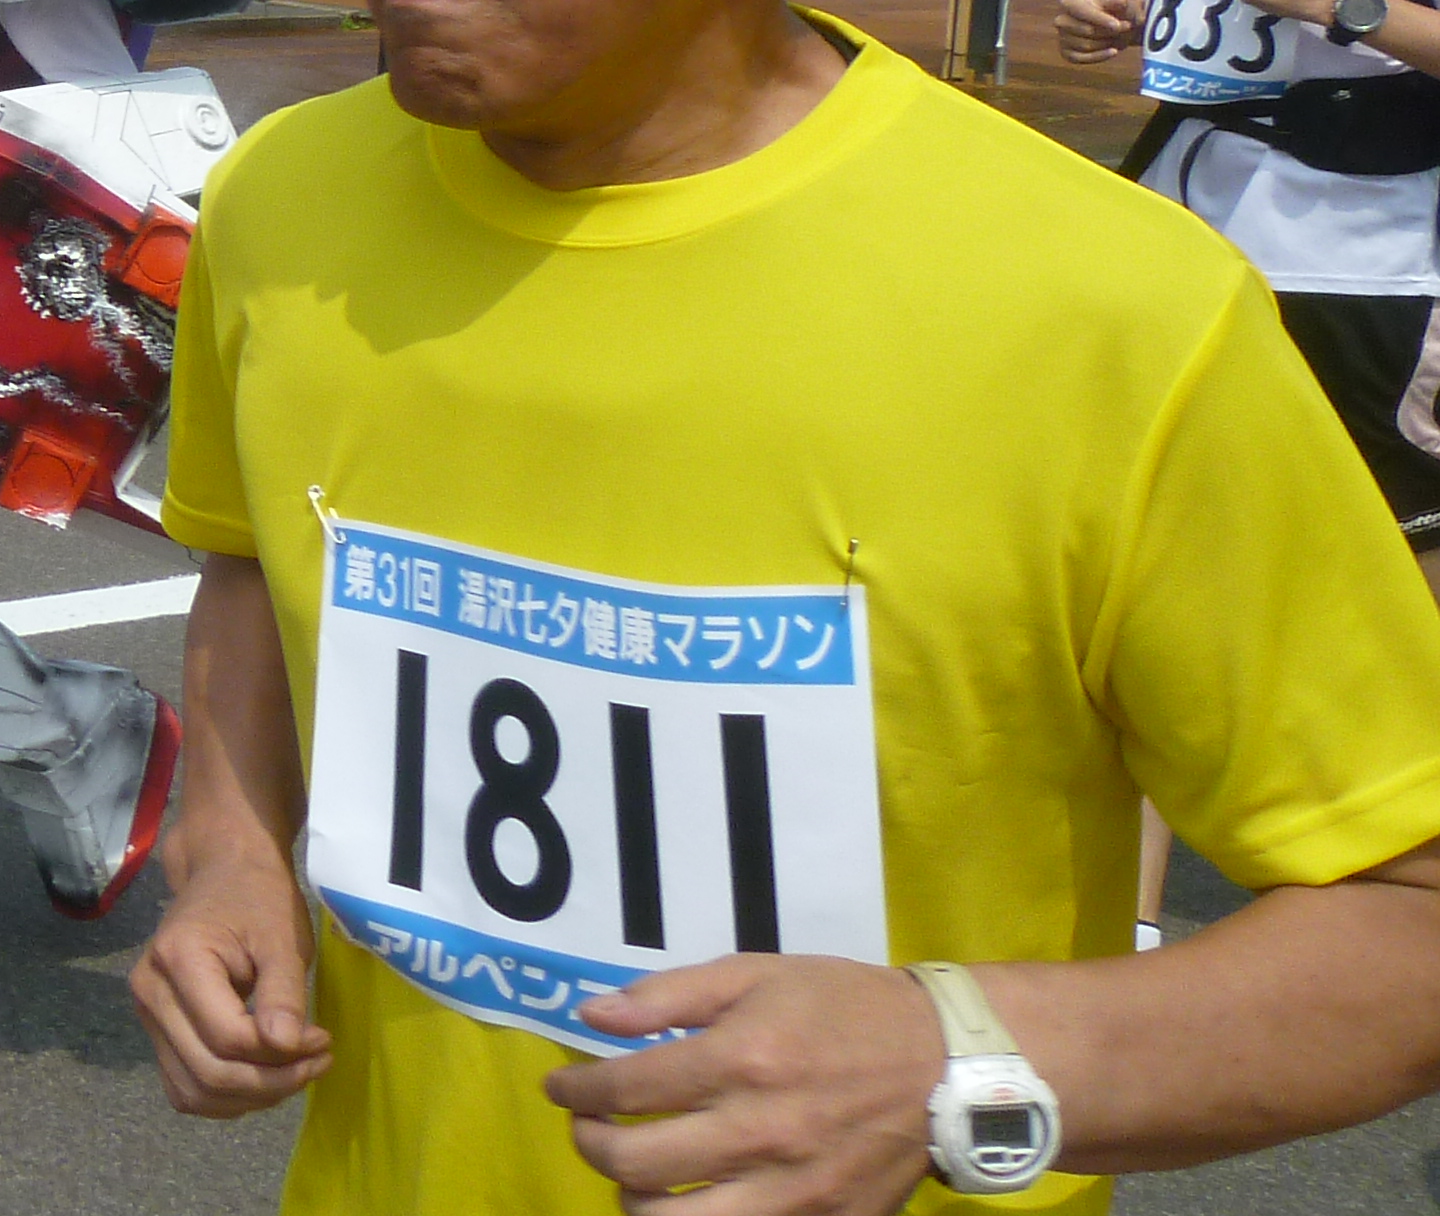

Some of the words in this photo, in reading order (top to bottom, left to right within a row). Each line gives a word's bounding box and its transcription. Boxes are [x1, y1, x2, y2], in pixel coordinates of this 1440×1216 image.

[343, 544, 442, 618] 第31回
[458, 568, 836, 672] 湯沢七夕健康マラソン
[388, 648, 781, 954] 1811
